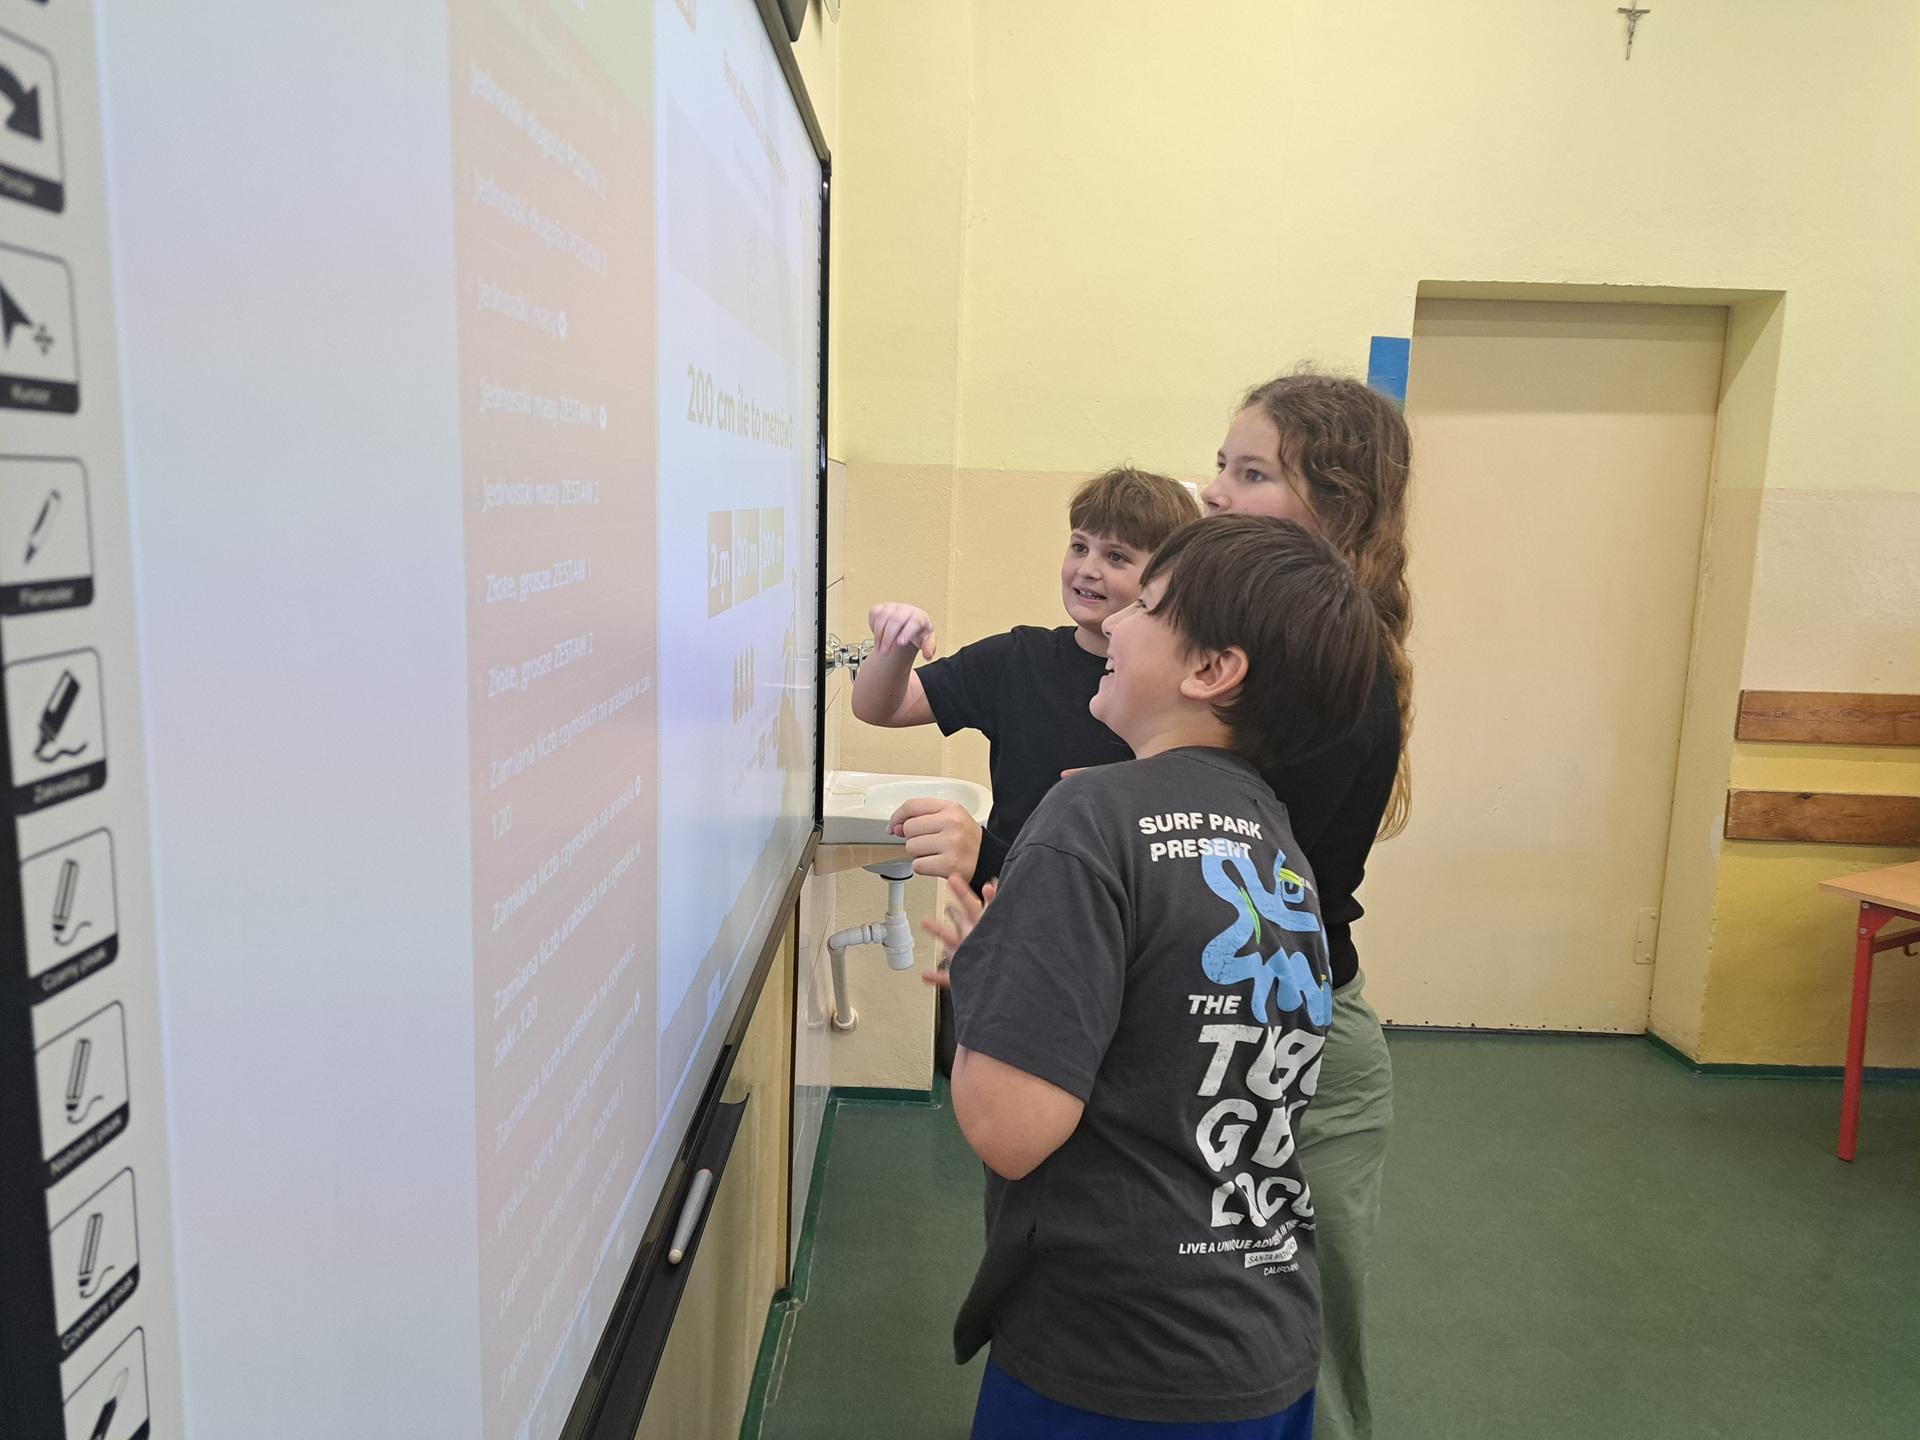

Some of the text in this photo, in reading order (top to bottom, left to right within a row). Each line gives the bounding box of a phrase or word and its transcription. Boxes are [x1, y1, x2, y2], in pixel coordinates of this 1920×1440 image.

[687, 362, 714, 428] 200
[717, 389, 735, 434] cm
[751, 397, 761, 440] to
[710, 543, 731, 588] 2 m
[519, 569, 551, 603] grosze
[521, 652, 553, 691] grosze
[1139, 812, 1263, 840] SURF PARK
[1150, 838, 1252, 862] PRESENT
[1188, 994, 1242, 1015] THE
[1179, 1242, 1207, 1254] LIVE
[1207, 1242, 1216, 1254] A
[1217, 1238, 1252, 1252] UNIQUE
